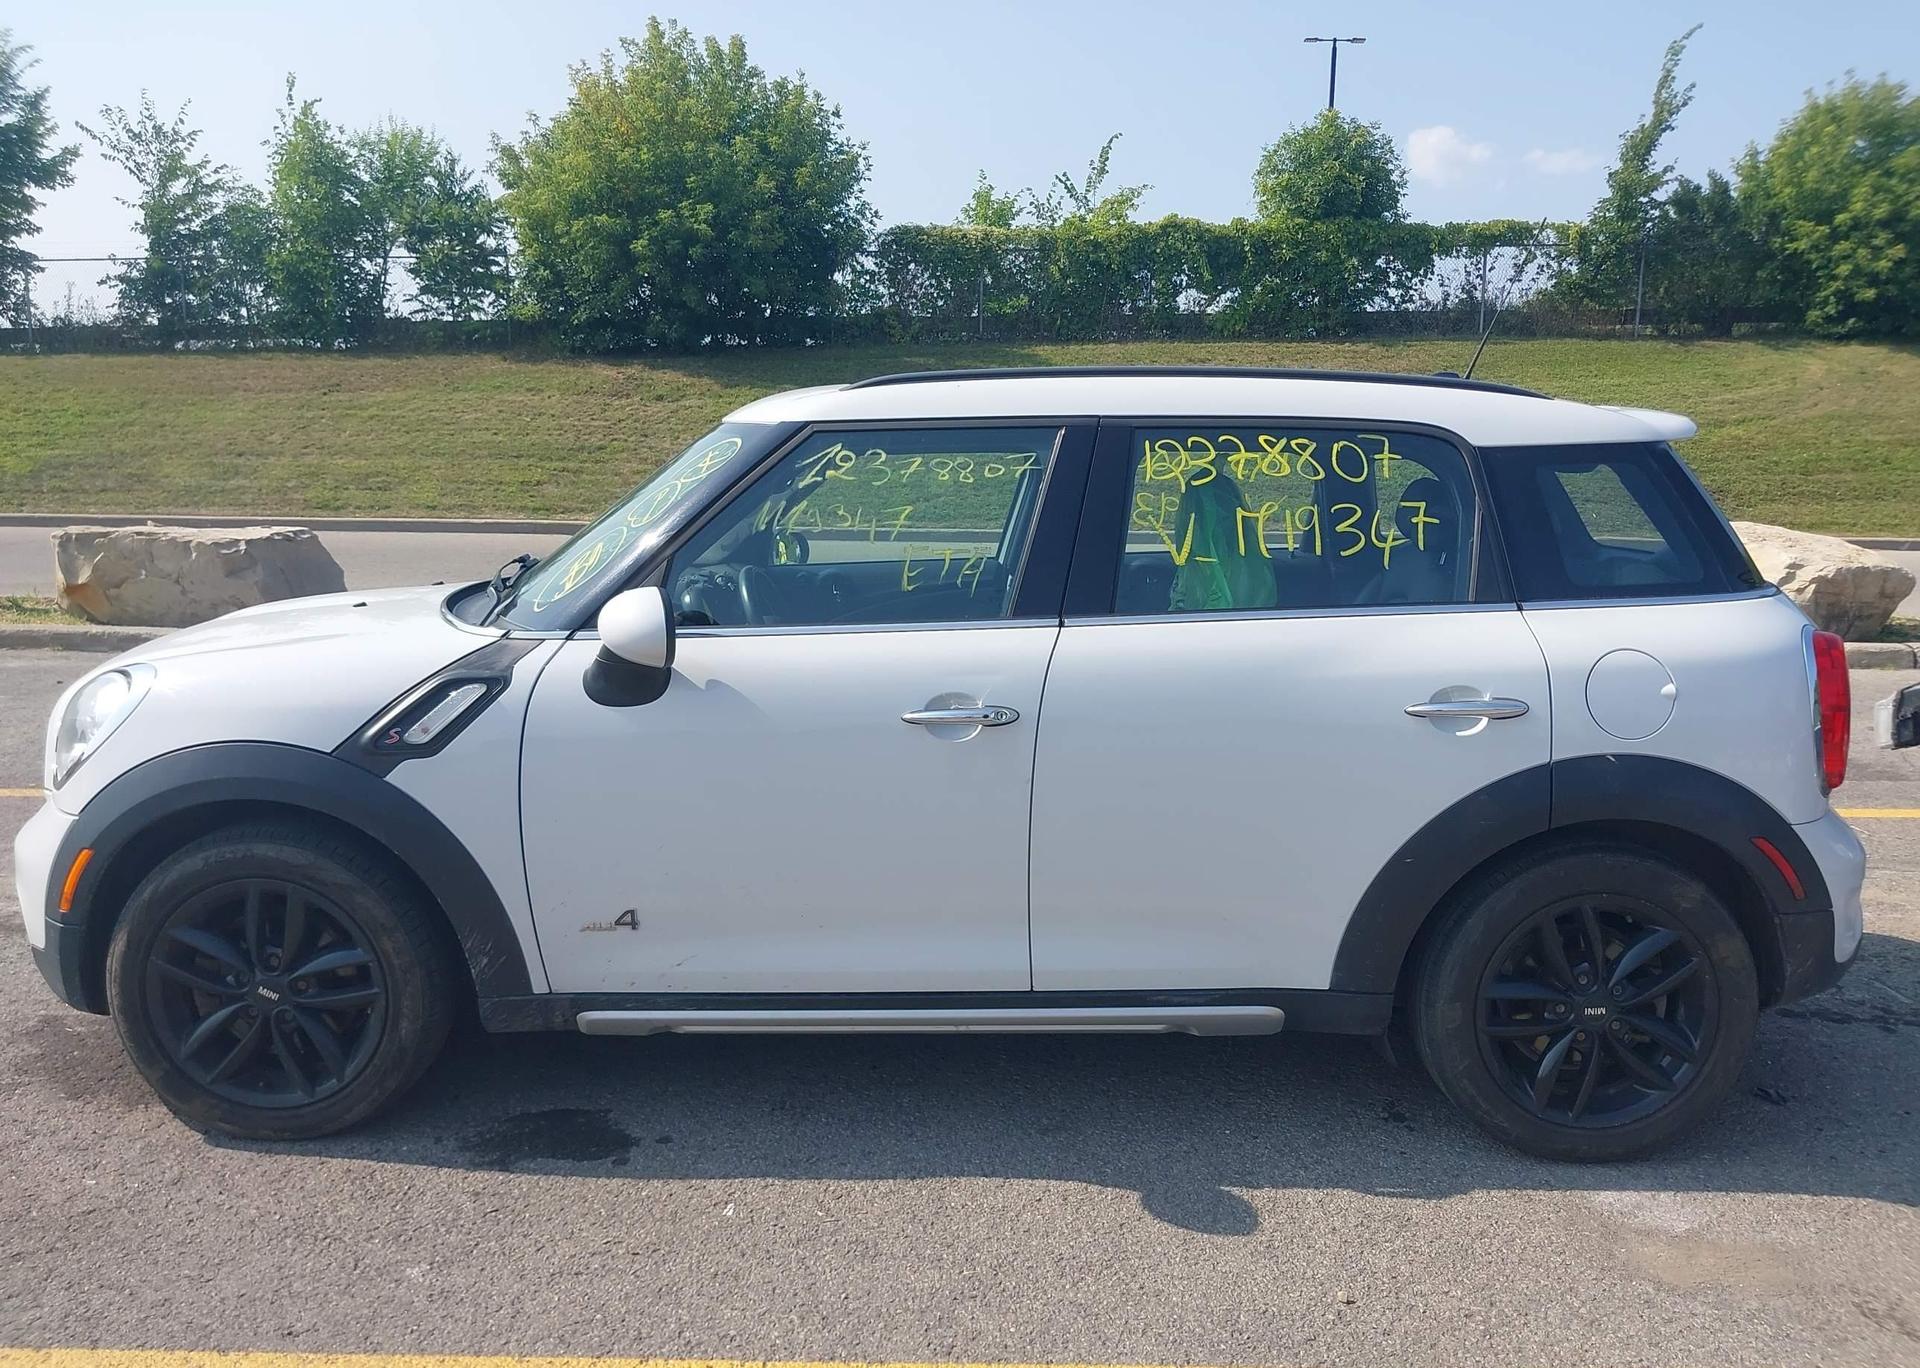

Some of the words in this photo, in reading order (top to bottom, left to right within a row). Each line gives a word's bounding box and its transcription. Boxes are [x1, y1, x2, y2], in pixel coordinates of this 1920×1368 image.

[383, 727, 402, 745] S
[257, 985, 280, 1001] MINI
[1584, 1006, 1607, 1016] MINI
